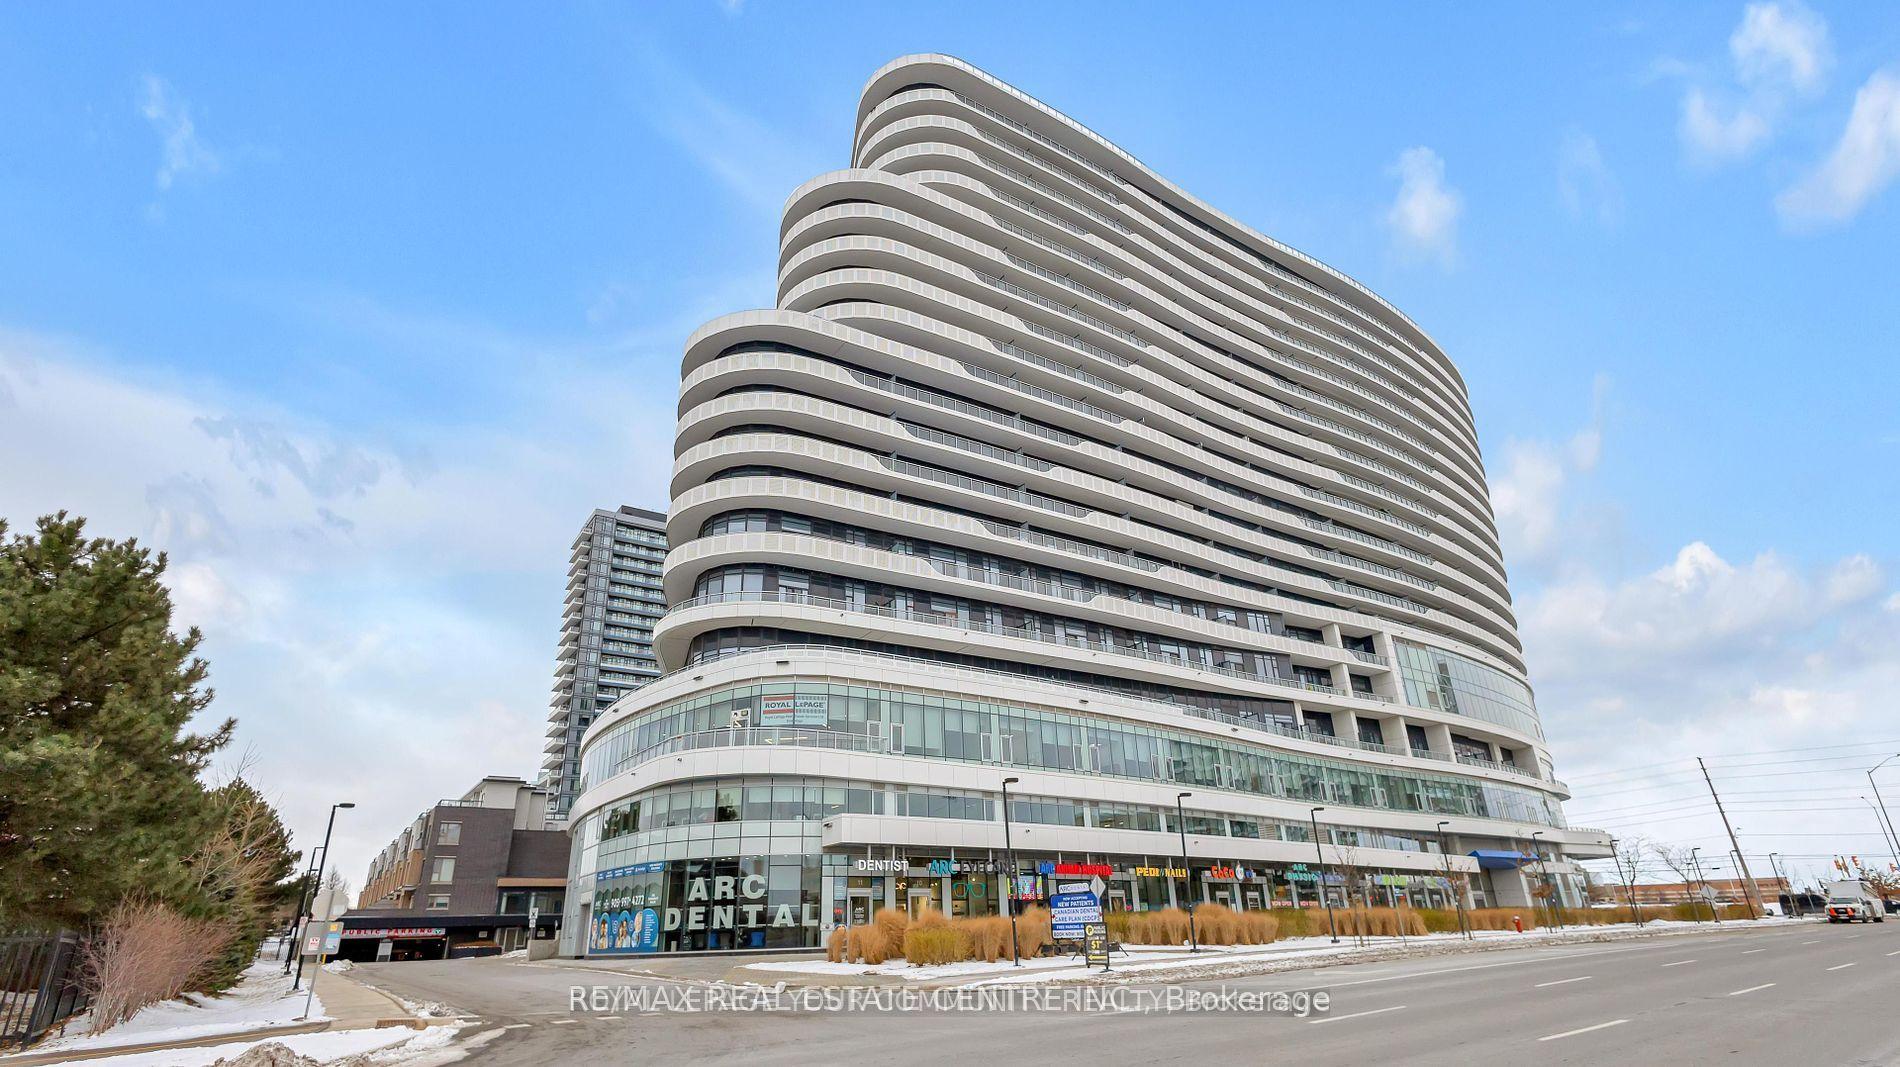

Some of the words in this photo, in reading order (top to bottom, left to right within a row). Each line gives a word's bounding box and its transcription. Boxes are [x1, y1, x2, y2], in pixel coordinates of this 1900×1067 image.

[858, 859, 908, 872] DENTIST
[930, 859, 958, 875] ARC
[1135, 866, 1160, 877] PEDI
[1165, 868, 1187, 878] NAILS
[688, 874, 766, 901] ARC
[664, 904, 819, 931] DENTAL
